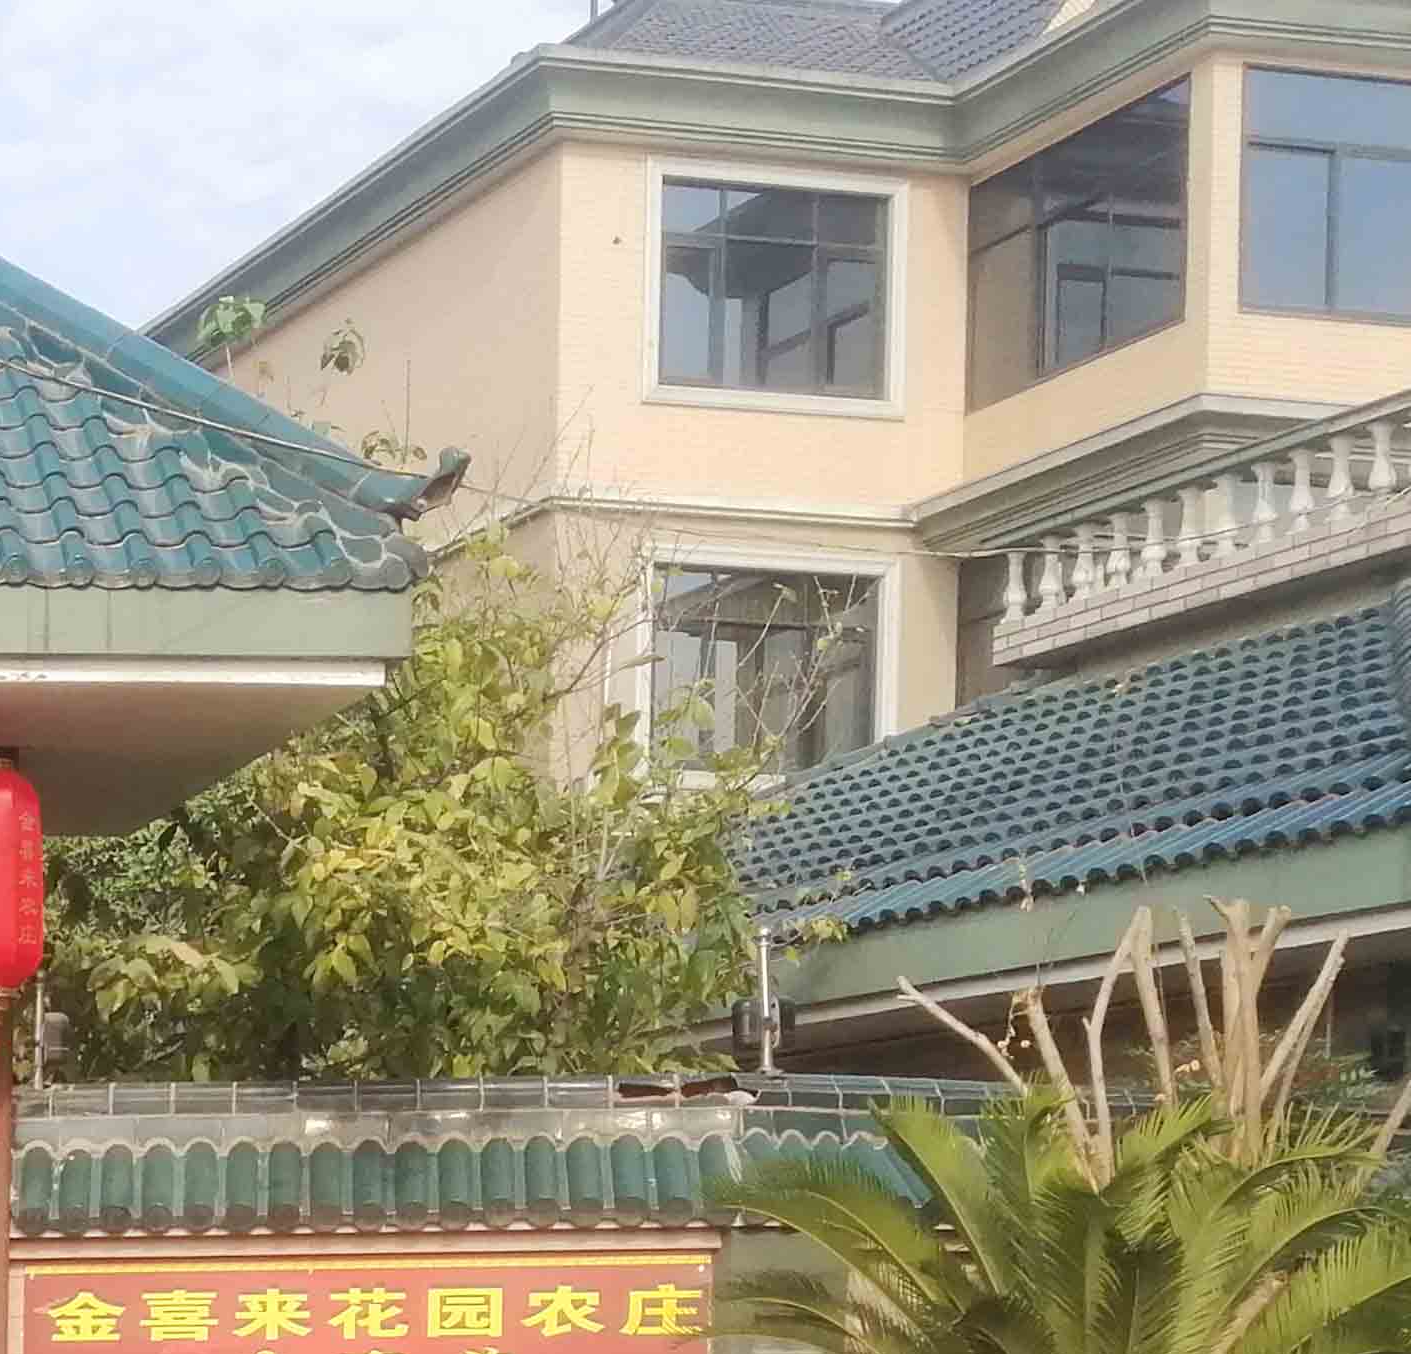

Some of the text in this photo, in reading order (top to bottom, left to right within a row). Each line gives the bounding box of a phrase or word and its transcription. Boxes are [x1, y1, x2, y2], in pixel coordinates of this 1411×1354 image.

[47, 1284, 704, 1342] 金喜来花园农庄
